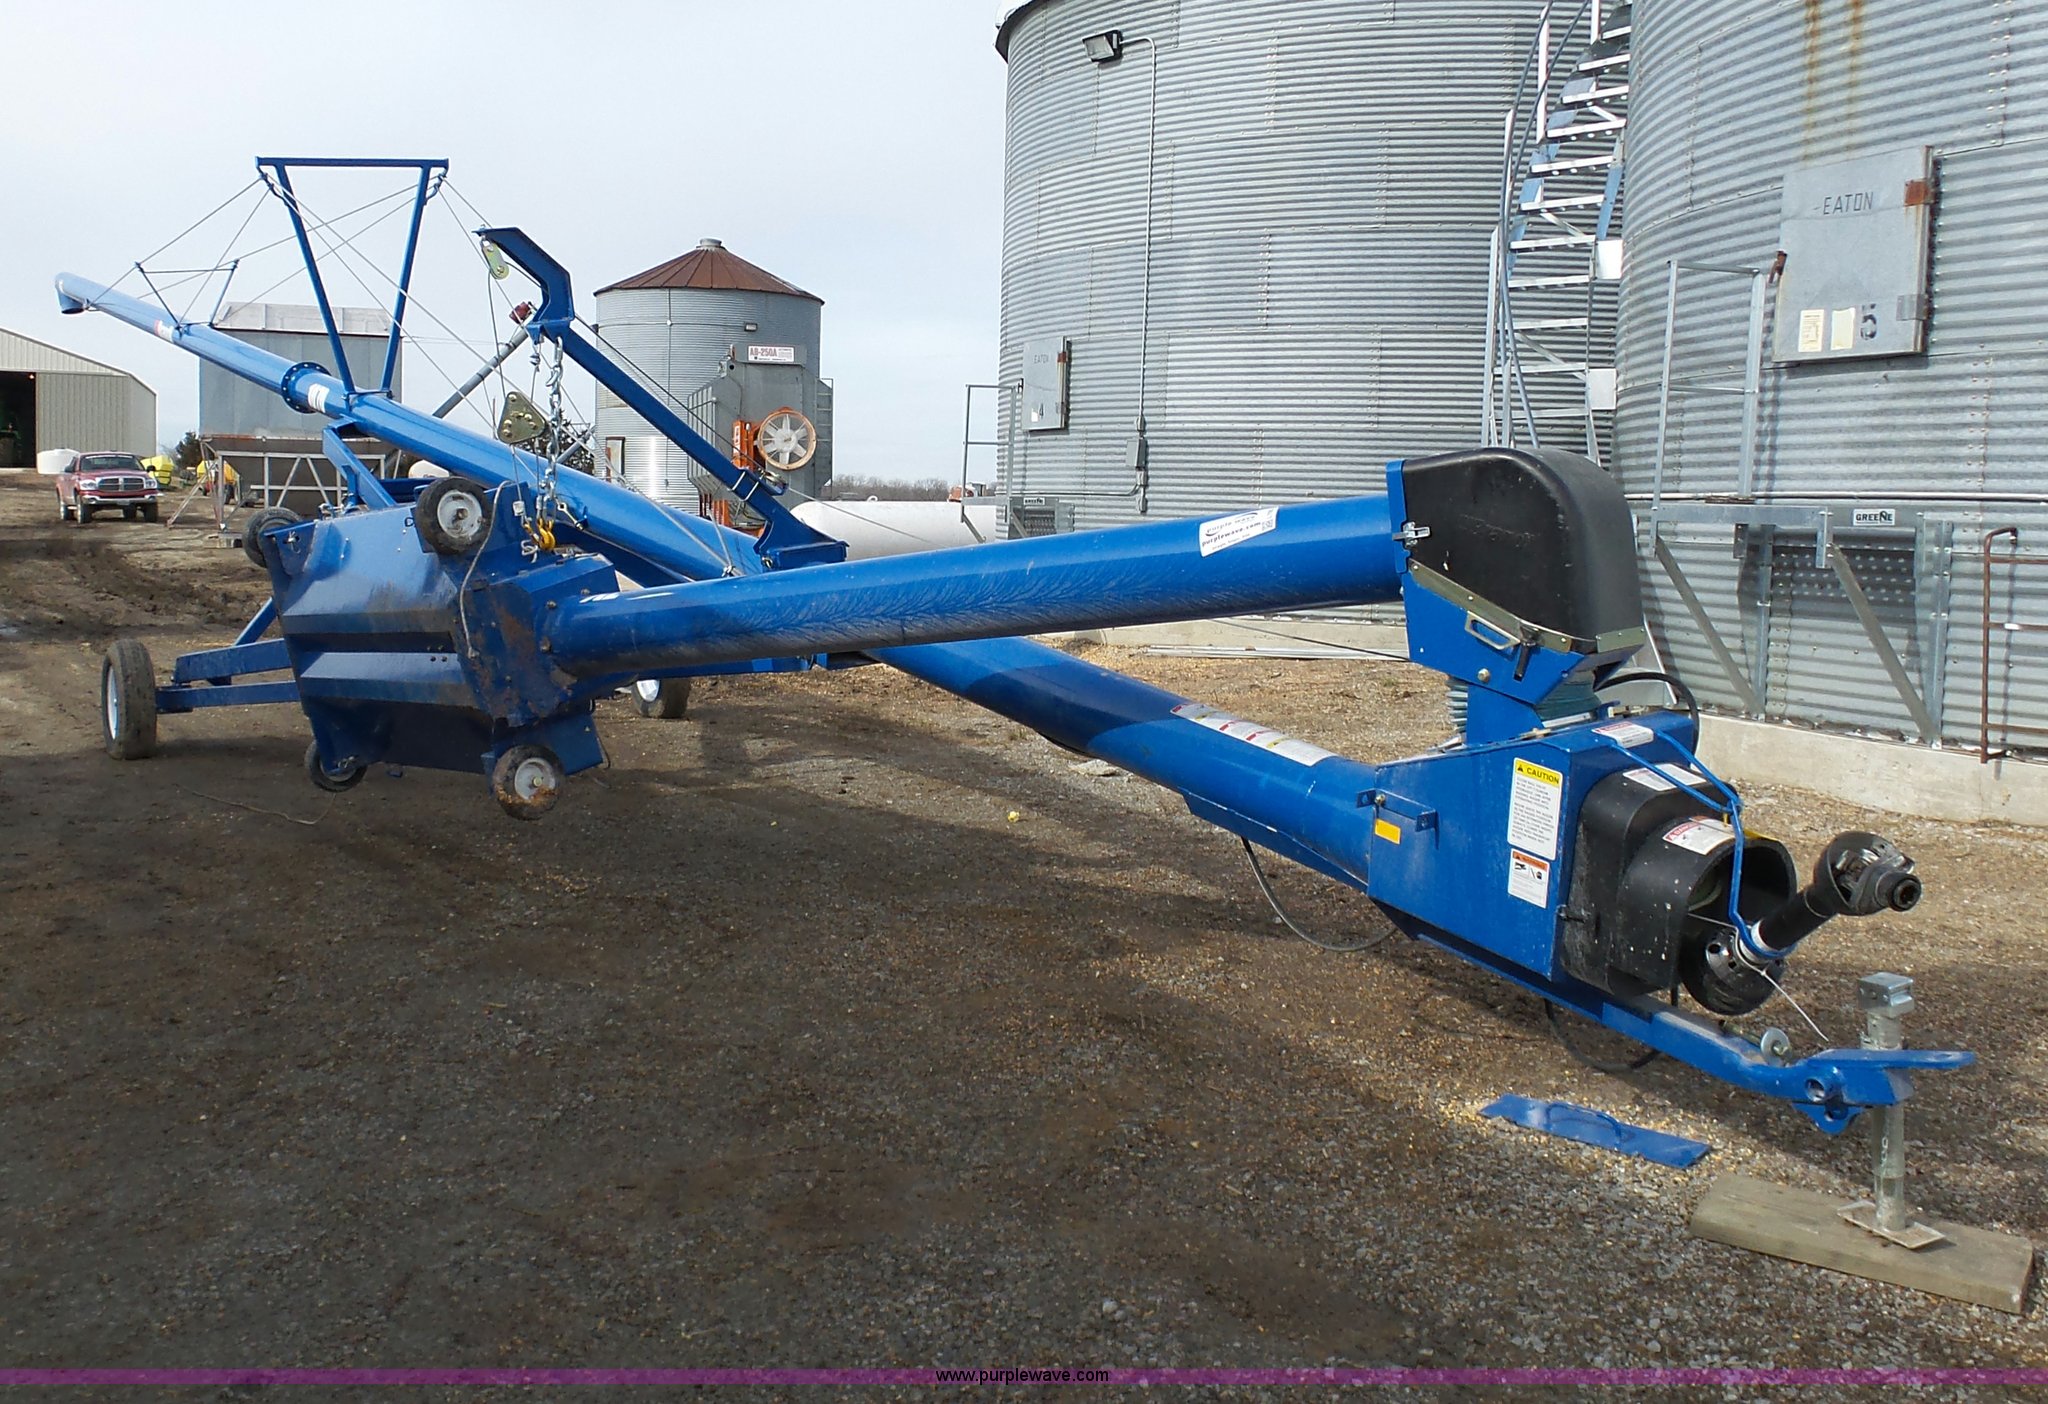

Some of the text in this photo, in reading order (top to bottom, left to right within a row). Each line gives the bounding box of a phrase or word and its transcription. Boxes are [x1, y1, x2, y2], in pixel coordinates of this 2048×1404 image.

[1823, 192, 1873, 215] EATON
[1860, 303, 1877, 340] 5
[750, 348, 777, 357] AB-250A
[1039, 404, 1044, 417] 4
[1856, 511, 1892, 522] GREENE
[1202, 522, 1261, 546] purplewave.com
[1526, 767, 1559, 785] CAUTION
